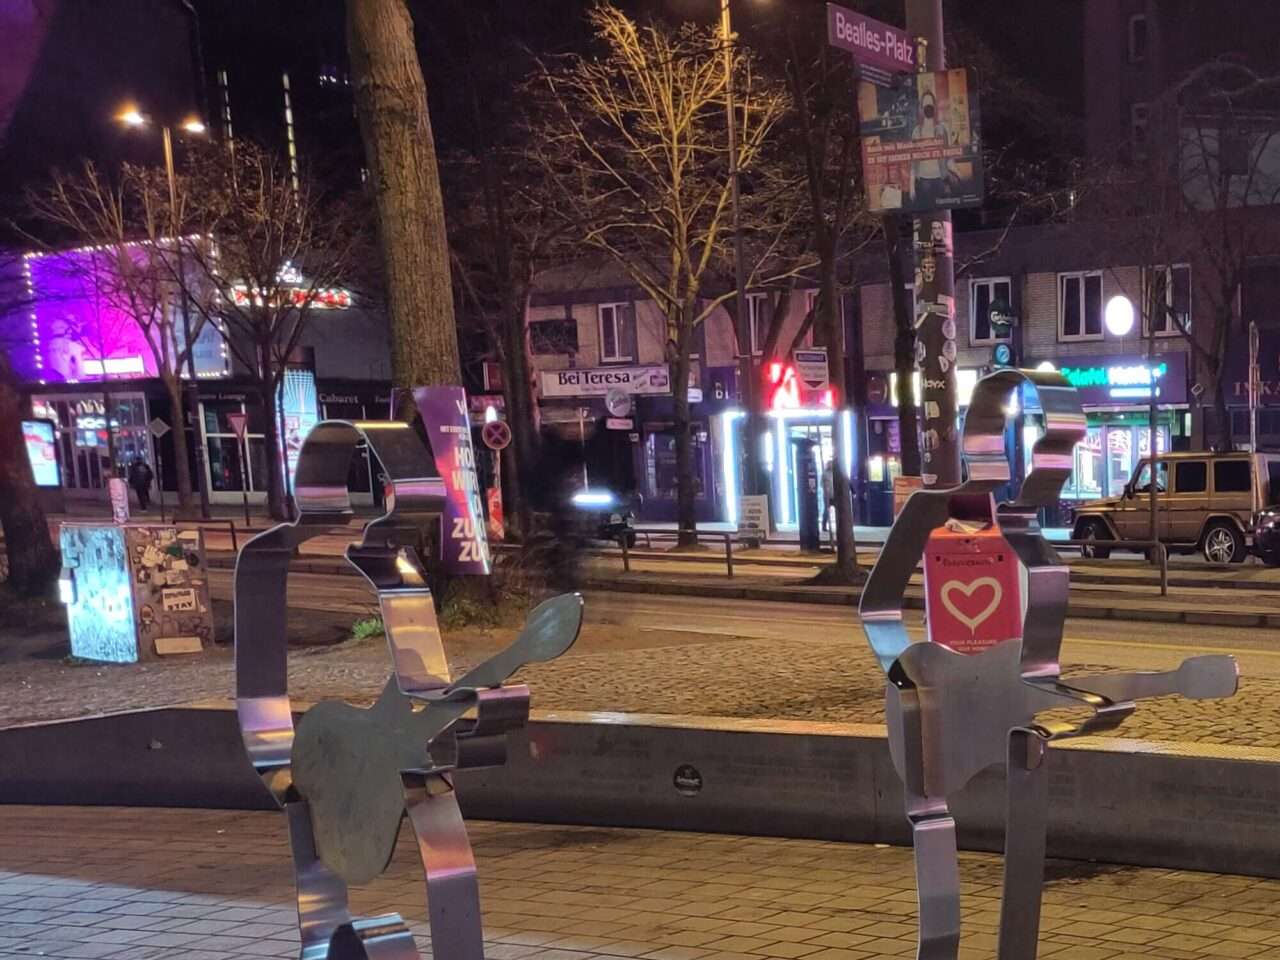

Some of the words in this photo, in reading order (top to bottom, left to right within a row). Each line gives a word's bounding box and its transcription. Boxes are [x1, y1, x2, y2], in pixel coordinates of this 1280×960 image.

[836, 12, 914, 64] Beatles-Platz
[558, 372, 580, 385] Bei
[582, 371, 630, 384] Teresa
[319, 393, 359, 403] Cabaret
